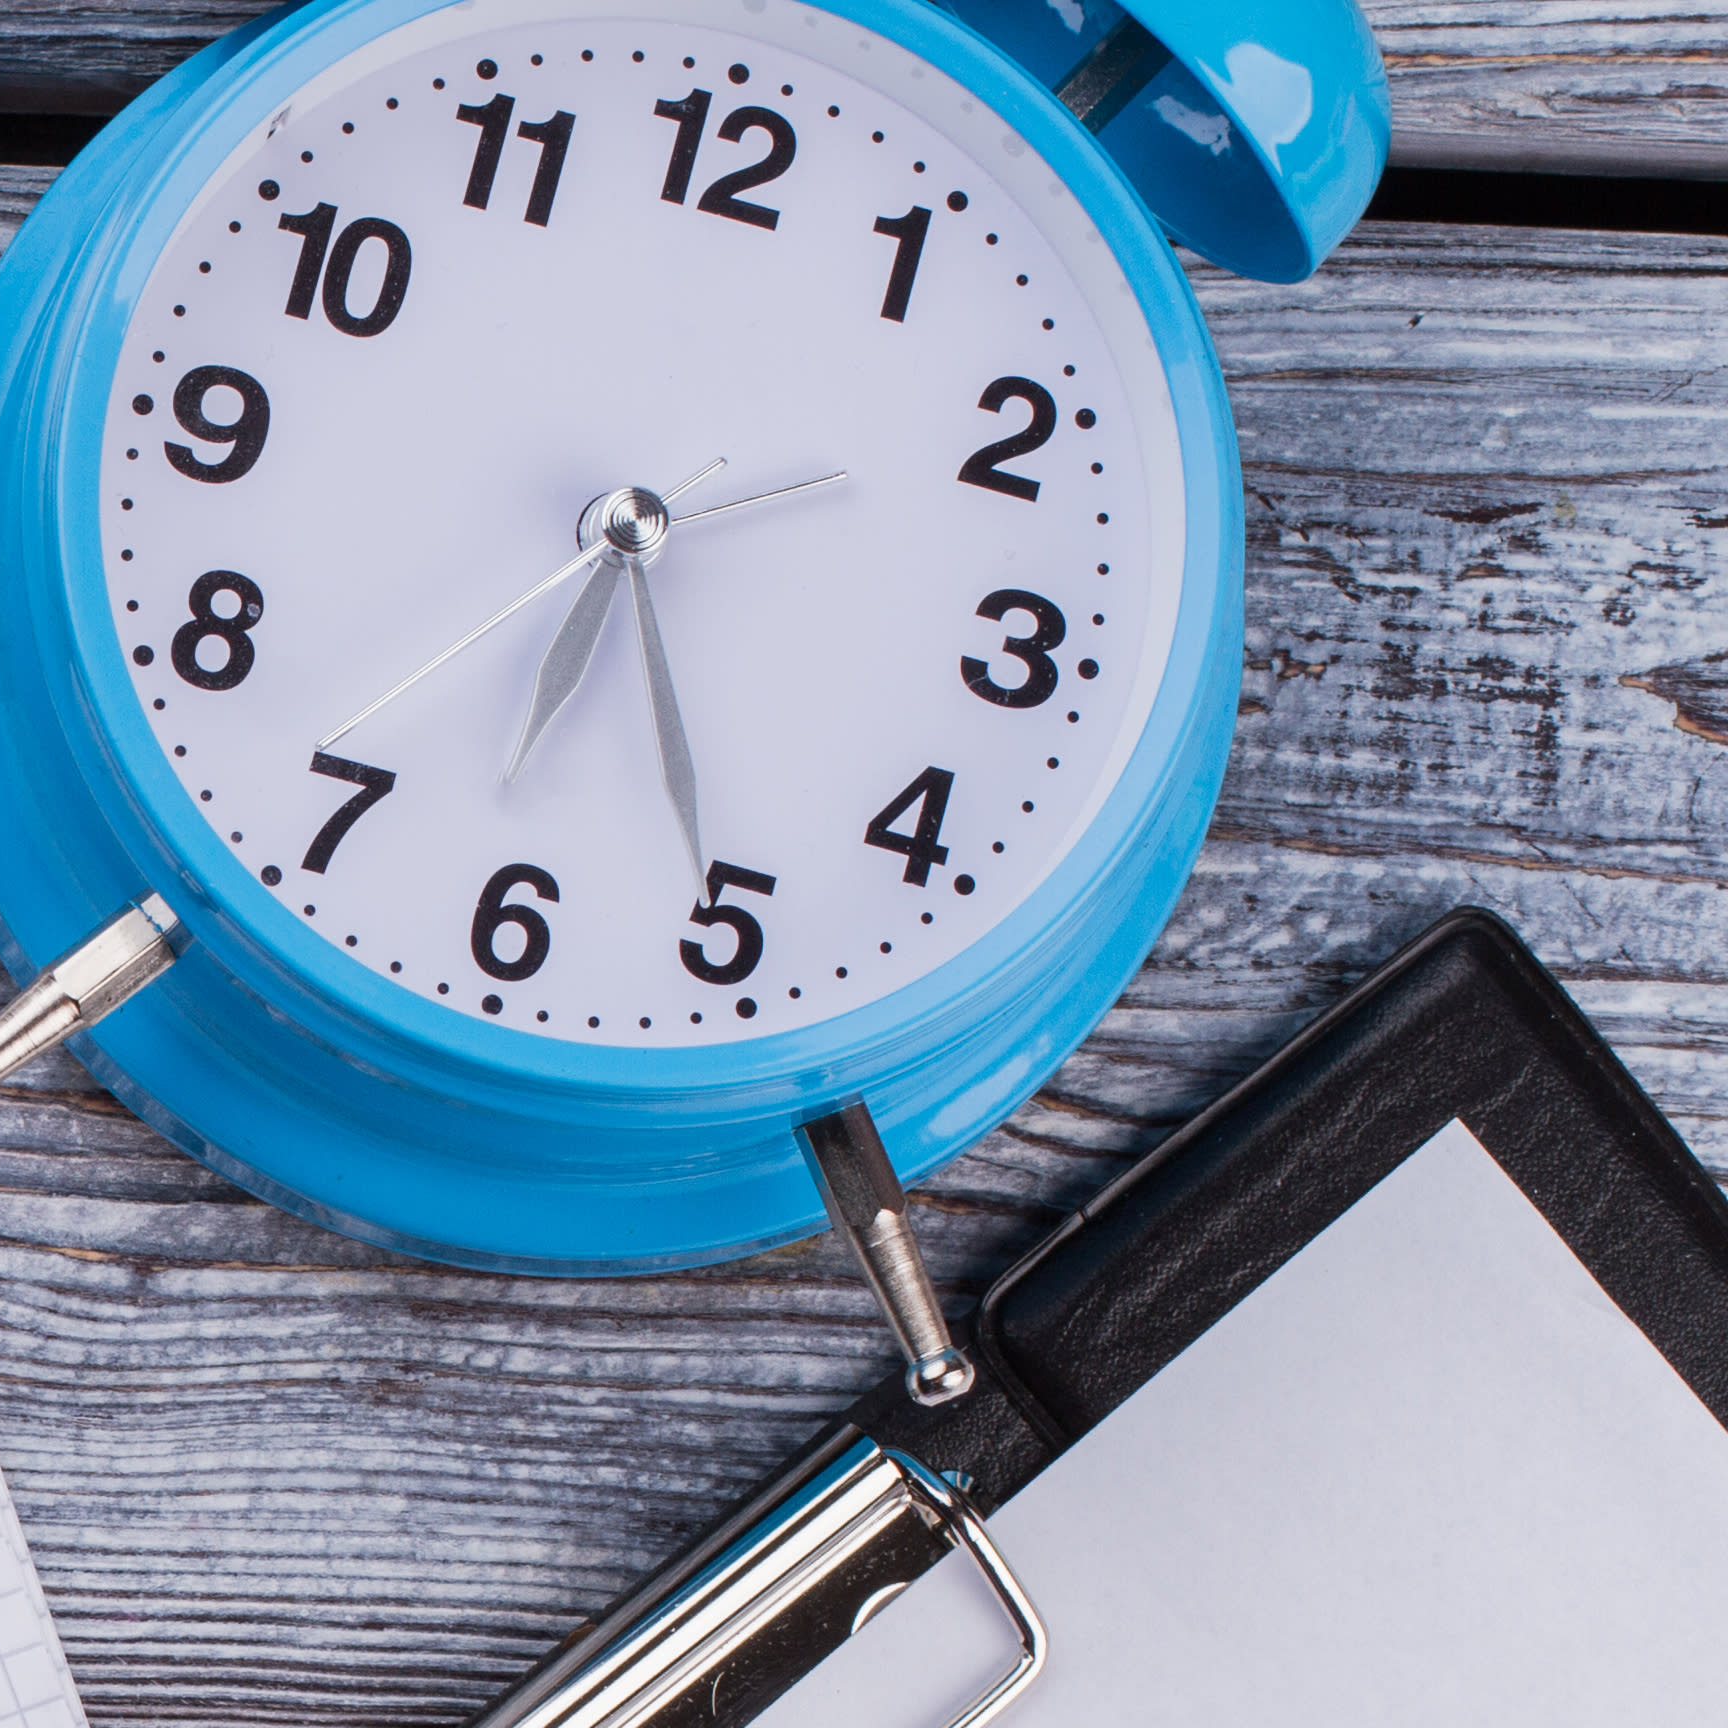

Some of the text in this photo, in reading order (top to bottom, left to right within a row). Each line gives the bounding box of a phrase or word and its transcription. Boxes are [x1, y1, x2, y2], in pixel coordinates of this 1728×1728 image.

[455, 92, 577, 228] 11
[653, 84, 797, 232] 12
[277, 201, 412, 338] 10
[873, 205, 933, 323] 1
[163, 364, 271, 484] 9
[957, 375, 1057, 503] 2
[170, 569, 265, 692] 8
[960, 588, 1067, 709] 3
[300, 751, 397, 875] 7
[863, 765, 955, 888] 4
[470, 863, 560, 982] 6
[679, 859, 777, 986] 5
